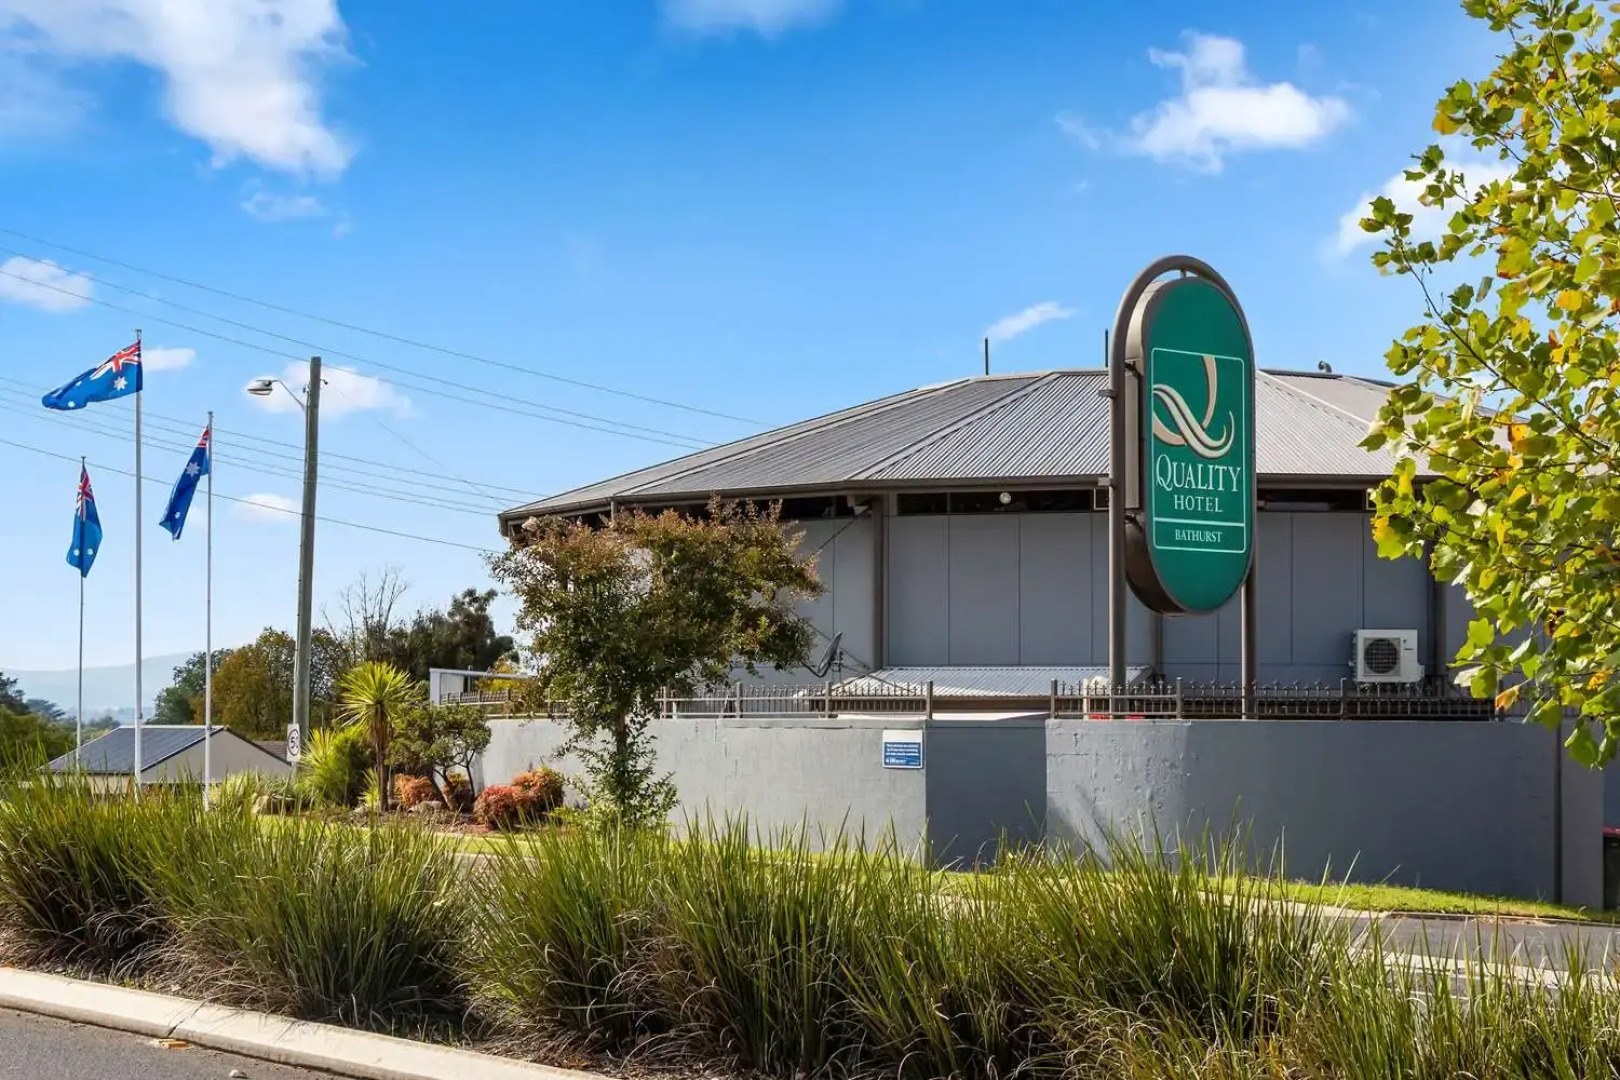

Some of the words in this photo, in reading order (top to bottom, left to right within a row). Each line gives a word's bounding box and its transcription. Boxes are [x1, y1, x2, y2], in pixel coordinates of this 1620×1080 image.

[1156, 454, 1241, 492] QUALITY
[1173, 494, 1223, 513] HOTEL
[1175, 529, 1223, 543] BATHURST
